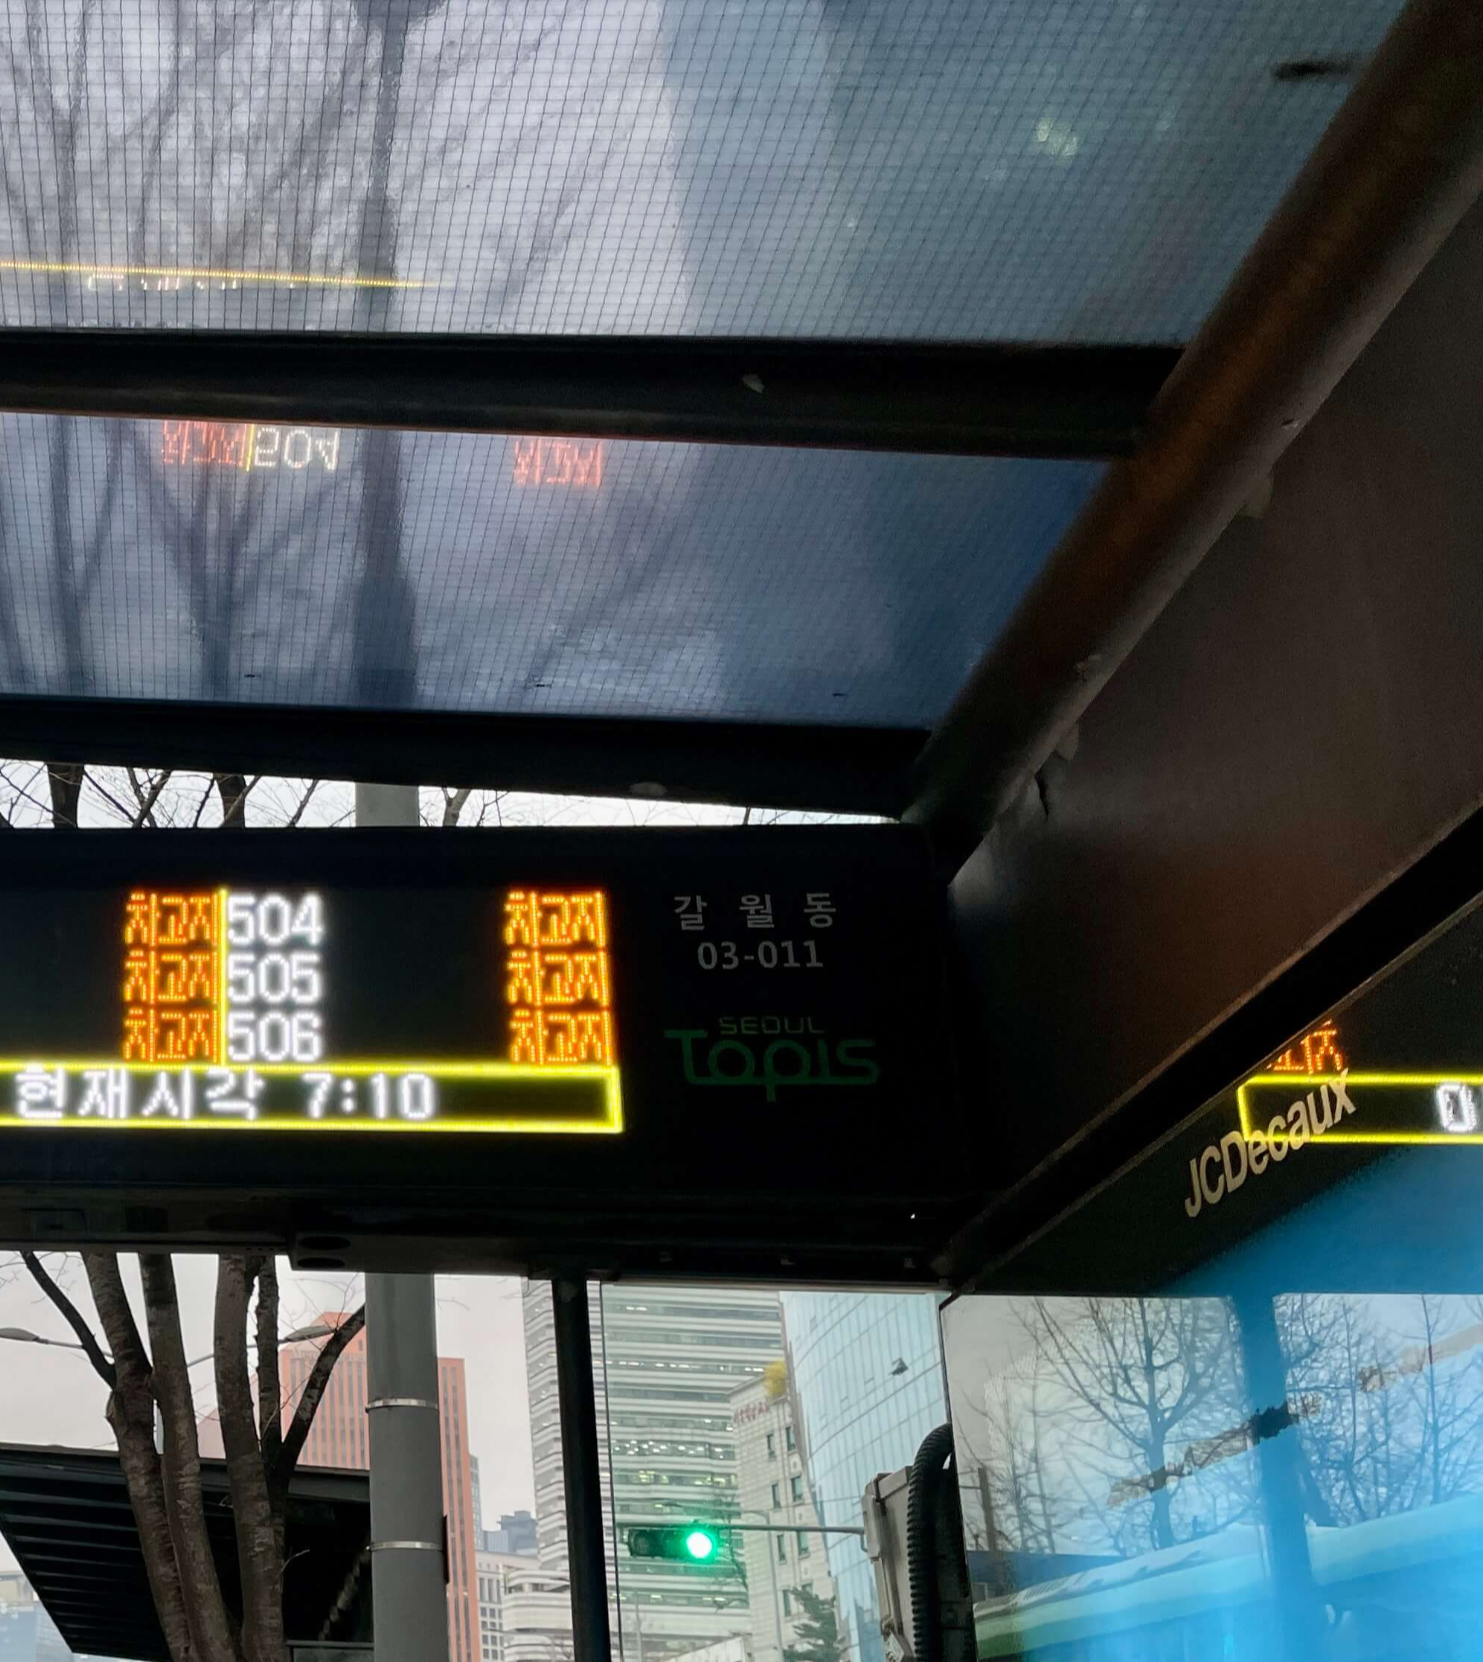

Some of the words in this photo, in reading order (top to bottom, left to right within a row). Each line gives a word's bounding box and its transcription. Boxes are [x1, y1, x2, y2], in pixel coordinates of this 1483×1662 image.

[124, 892, 219, 947] 차고지
[226, 892, 323, 945] 504
[506, 891, 607, 948] 차고지
[123, 950, 219, 1004] 차고지
[226, 951, 322, 1004] 505
[508, 951, 609, 1007] 차고지
[697, 940, 824, 970] 03-011
[123, 1008, 219, 1062] 차고지
[226, 1010, 322, 1063] 506
[511, 1009, 614, 1066] 차고지
[719, 1016, 825, 1035] SEOUL
[14, 1063, 266, 1121] 현재시각
[300, 1072, 436, 1120] 7:10
[1184, 1067, 1357, 1218] JCDecaux
